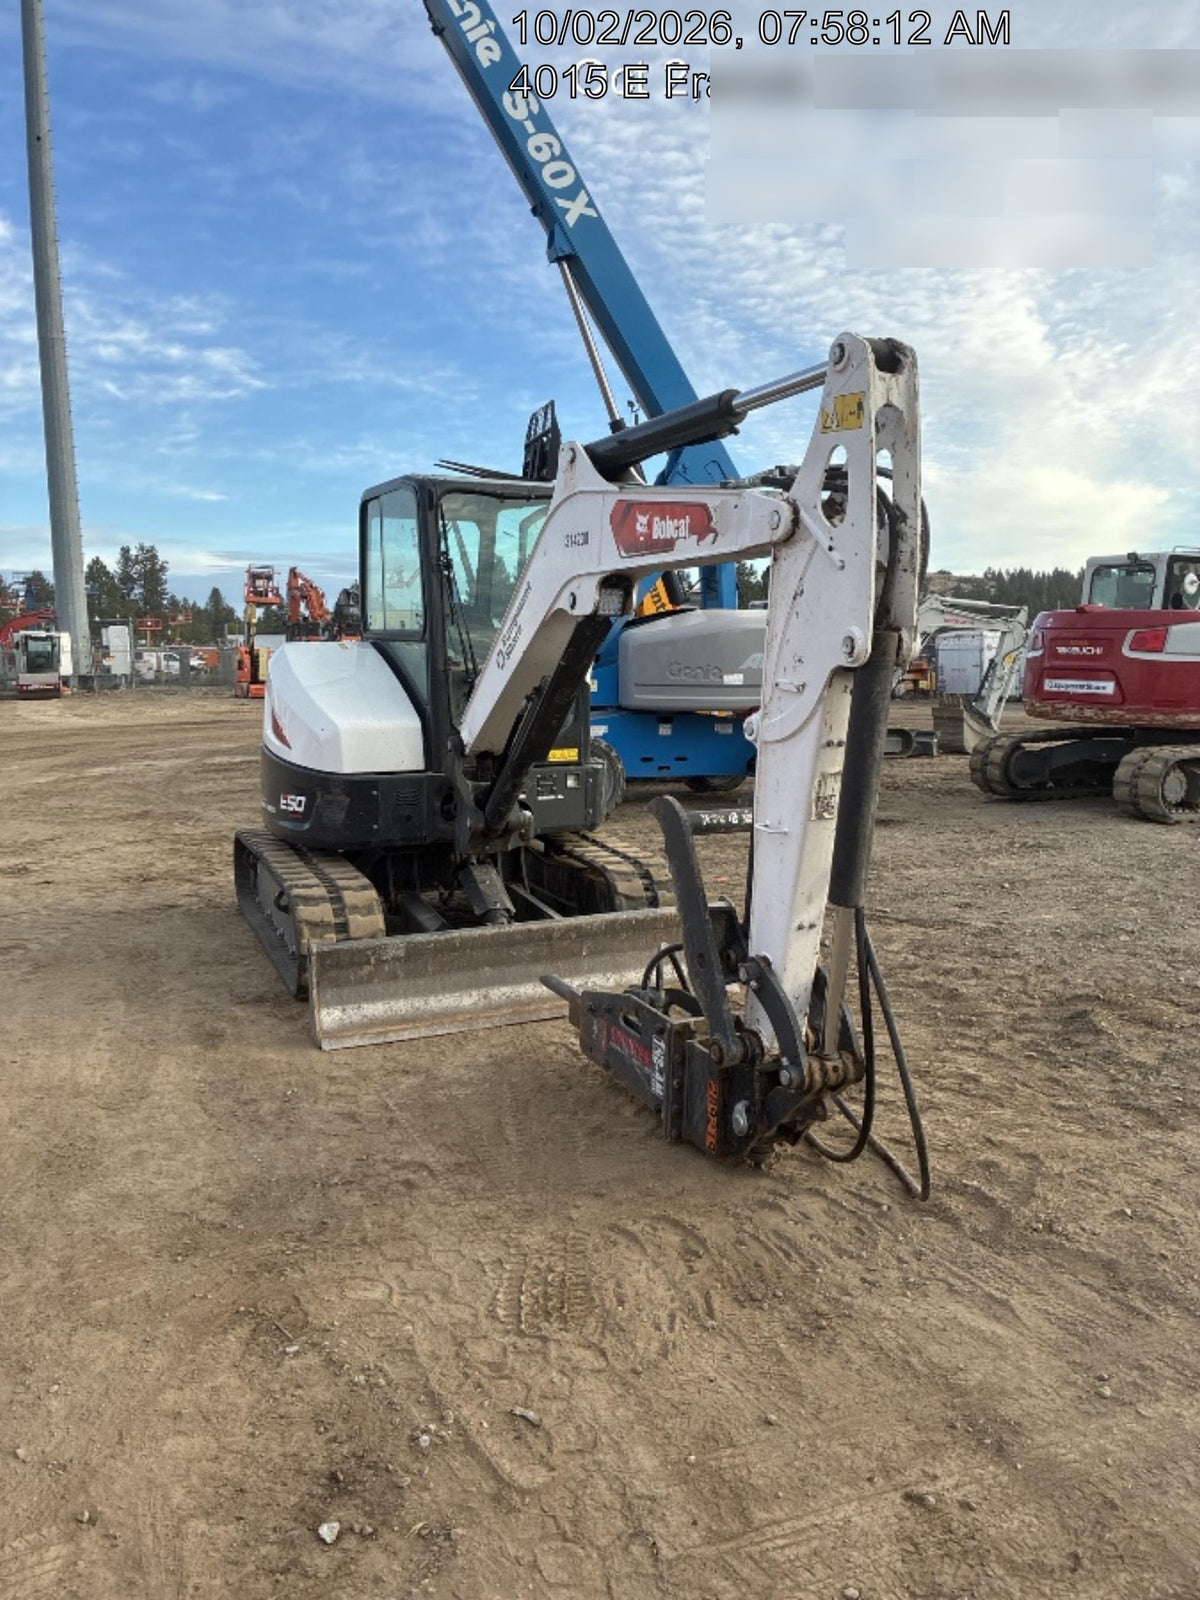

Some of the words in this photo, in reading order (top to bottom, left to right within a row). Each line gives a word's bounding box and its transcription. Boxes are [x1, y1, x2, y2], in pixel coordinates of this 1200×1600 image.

[446, 0, 502, 68] nie
[652, 515, 690, 540] Bobcat
[665, 660, 723, 681] Genie
[280, 793, 306, 812] E50
